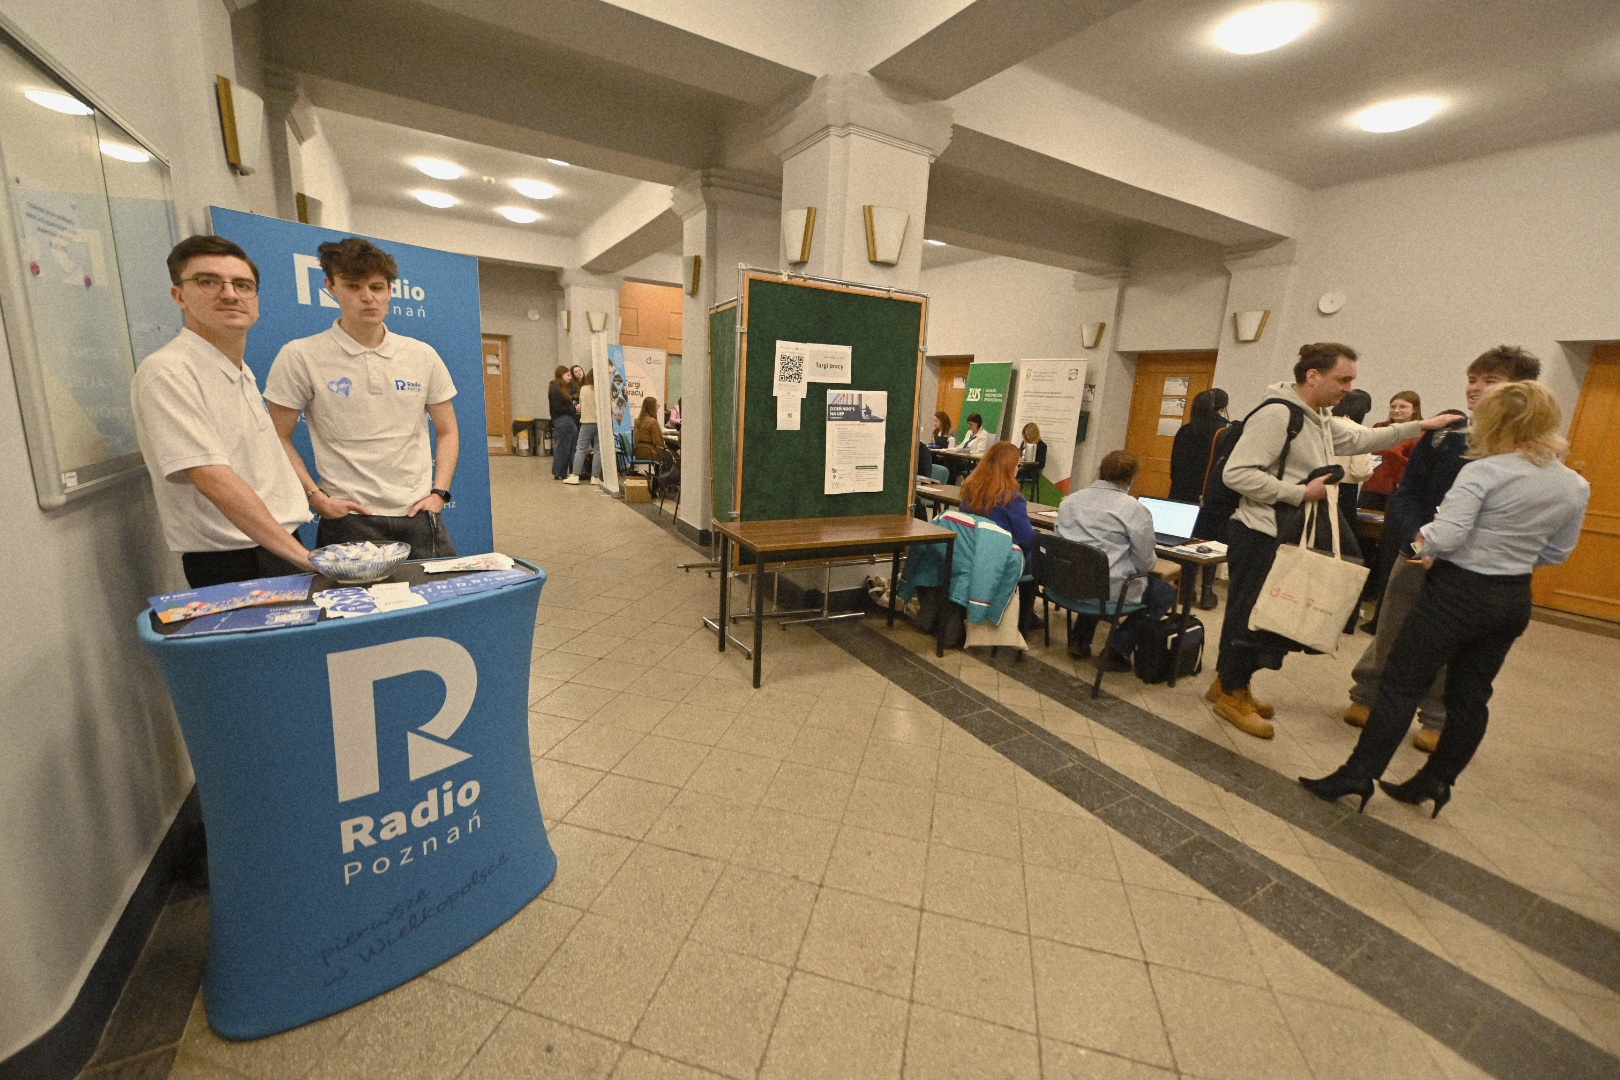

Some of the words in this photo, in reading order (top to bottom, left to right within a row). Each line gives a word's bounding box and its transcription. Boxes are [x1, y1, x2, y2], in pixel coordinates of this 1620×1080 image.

[390, 278, 426, 301] dio
[392, 305, 426, 318] nań
[339, 779, 483, 855] Radio
[342, 811, 483, 886] Poznań
[358, 854, 509, 963] Wielkopolsce
